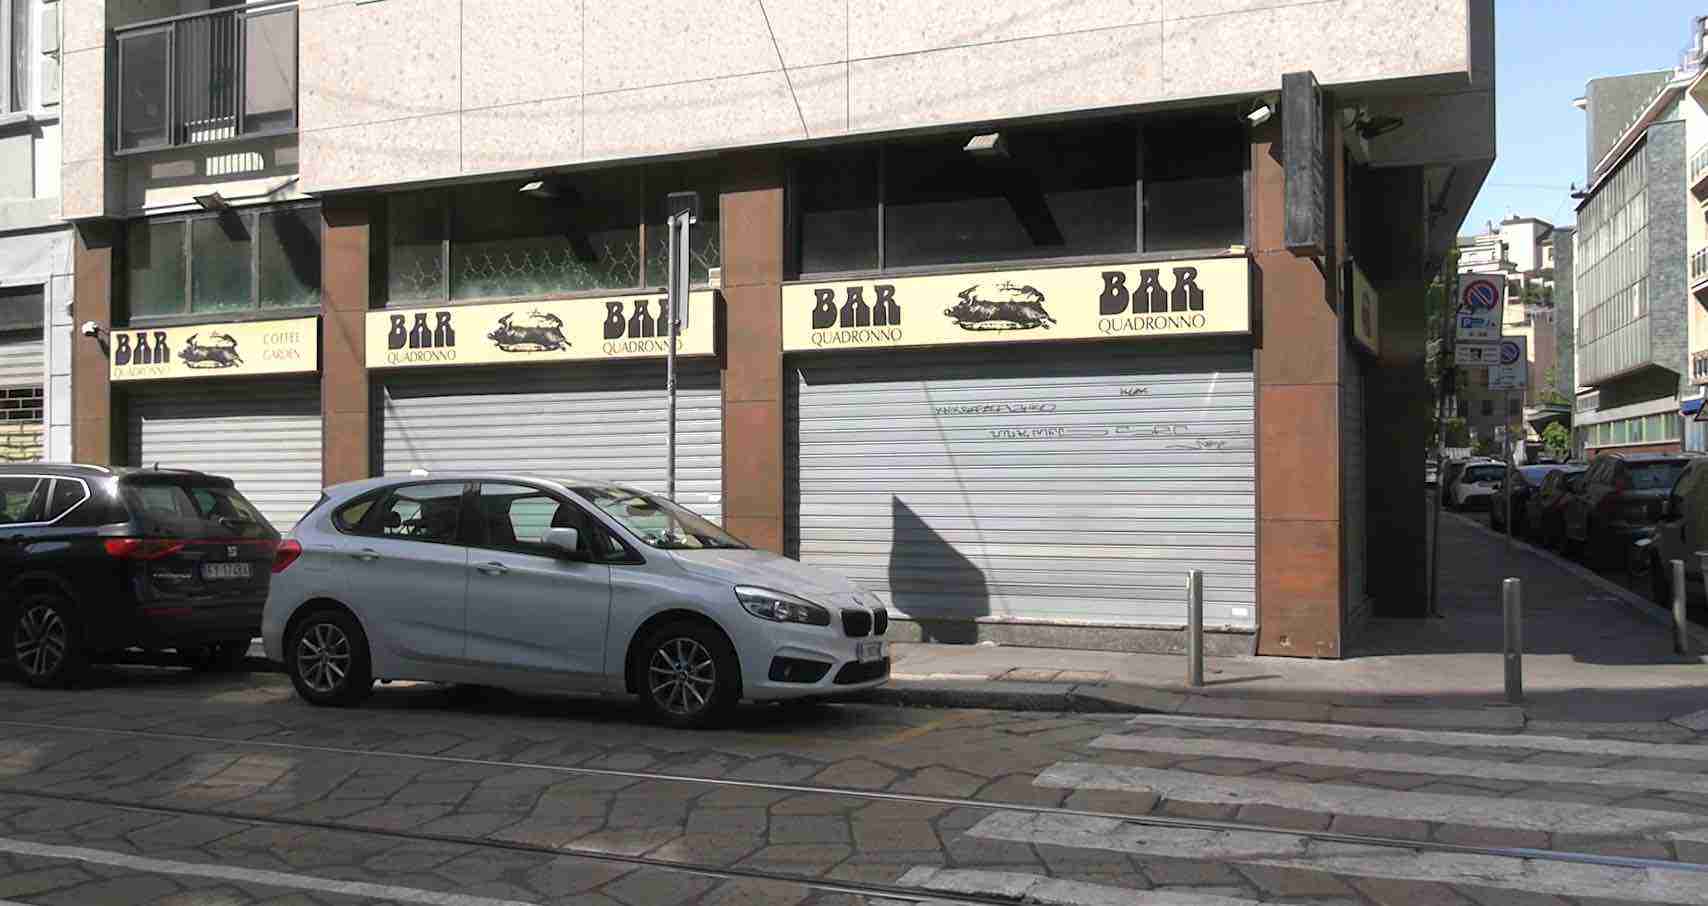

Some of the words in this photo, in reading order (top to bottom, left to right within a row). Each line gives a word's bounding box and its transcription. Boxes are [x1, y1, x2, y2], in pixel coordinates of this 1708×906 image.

[812, 284, 901, 330] BAR
[1099, 267, 1204, 315] BAR
[388, 311, 456, 350] BAR
[811, 328, 902, 347] QUADRONNO
[1098, 313, 1206, 335] QUADRONNO
[115, 331, 170, 366] BAR
[387, 349, 456, 364] QUADRONNO
